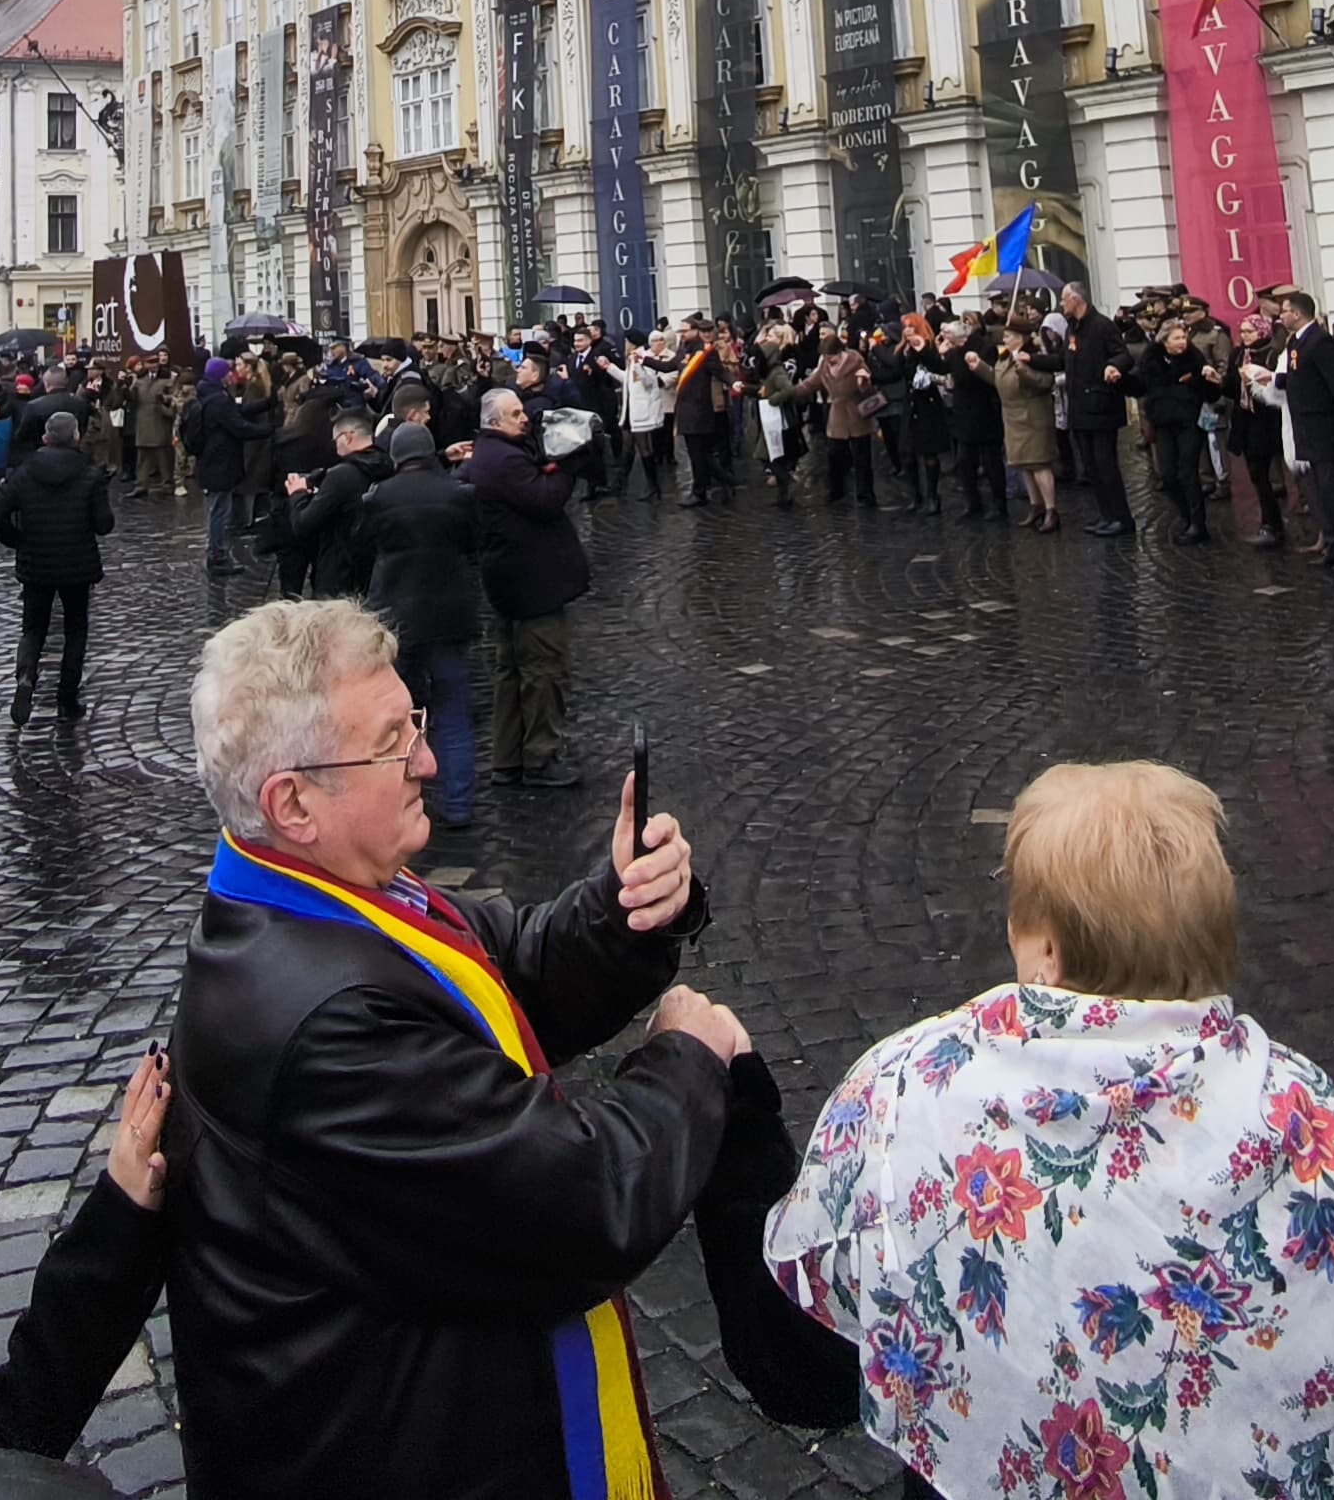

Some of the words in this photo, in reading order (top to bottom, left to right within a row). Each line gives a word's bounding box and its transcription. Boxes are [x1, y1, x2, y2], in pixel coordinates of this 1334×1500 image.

[512, 32, 526, 139] FIKL
[831, 103, 892, 127] ROBERTO
[838, 126, 888, 150] LONGHI
[507, 152, 517, 217] ROCADA
[608, 22, 634, 331] CARAVAGGIO
[521, 191, 531, 211] DE
[524, 217, 534, 270] ANIMA
[511, 223, 523, 320] POSTBAROC
[95, 295, 119, 338] art
[95, 336, 122, 353] united
